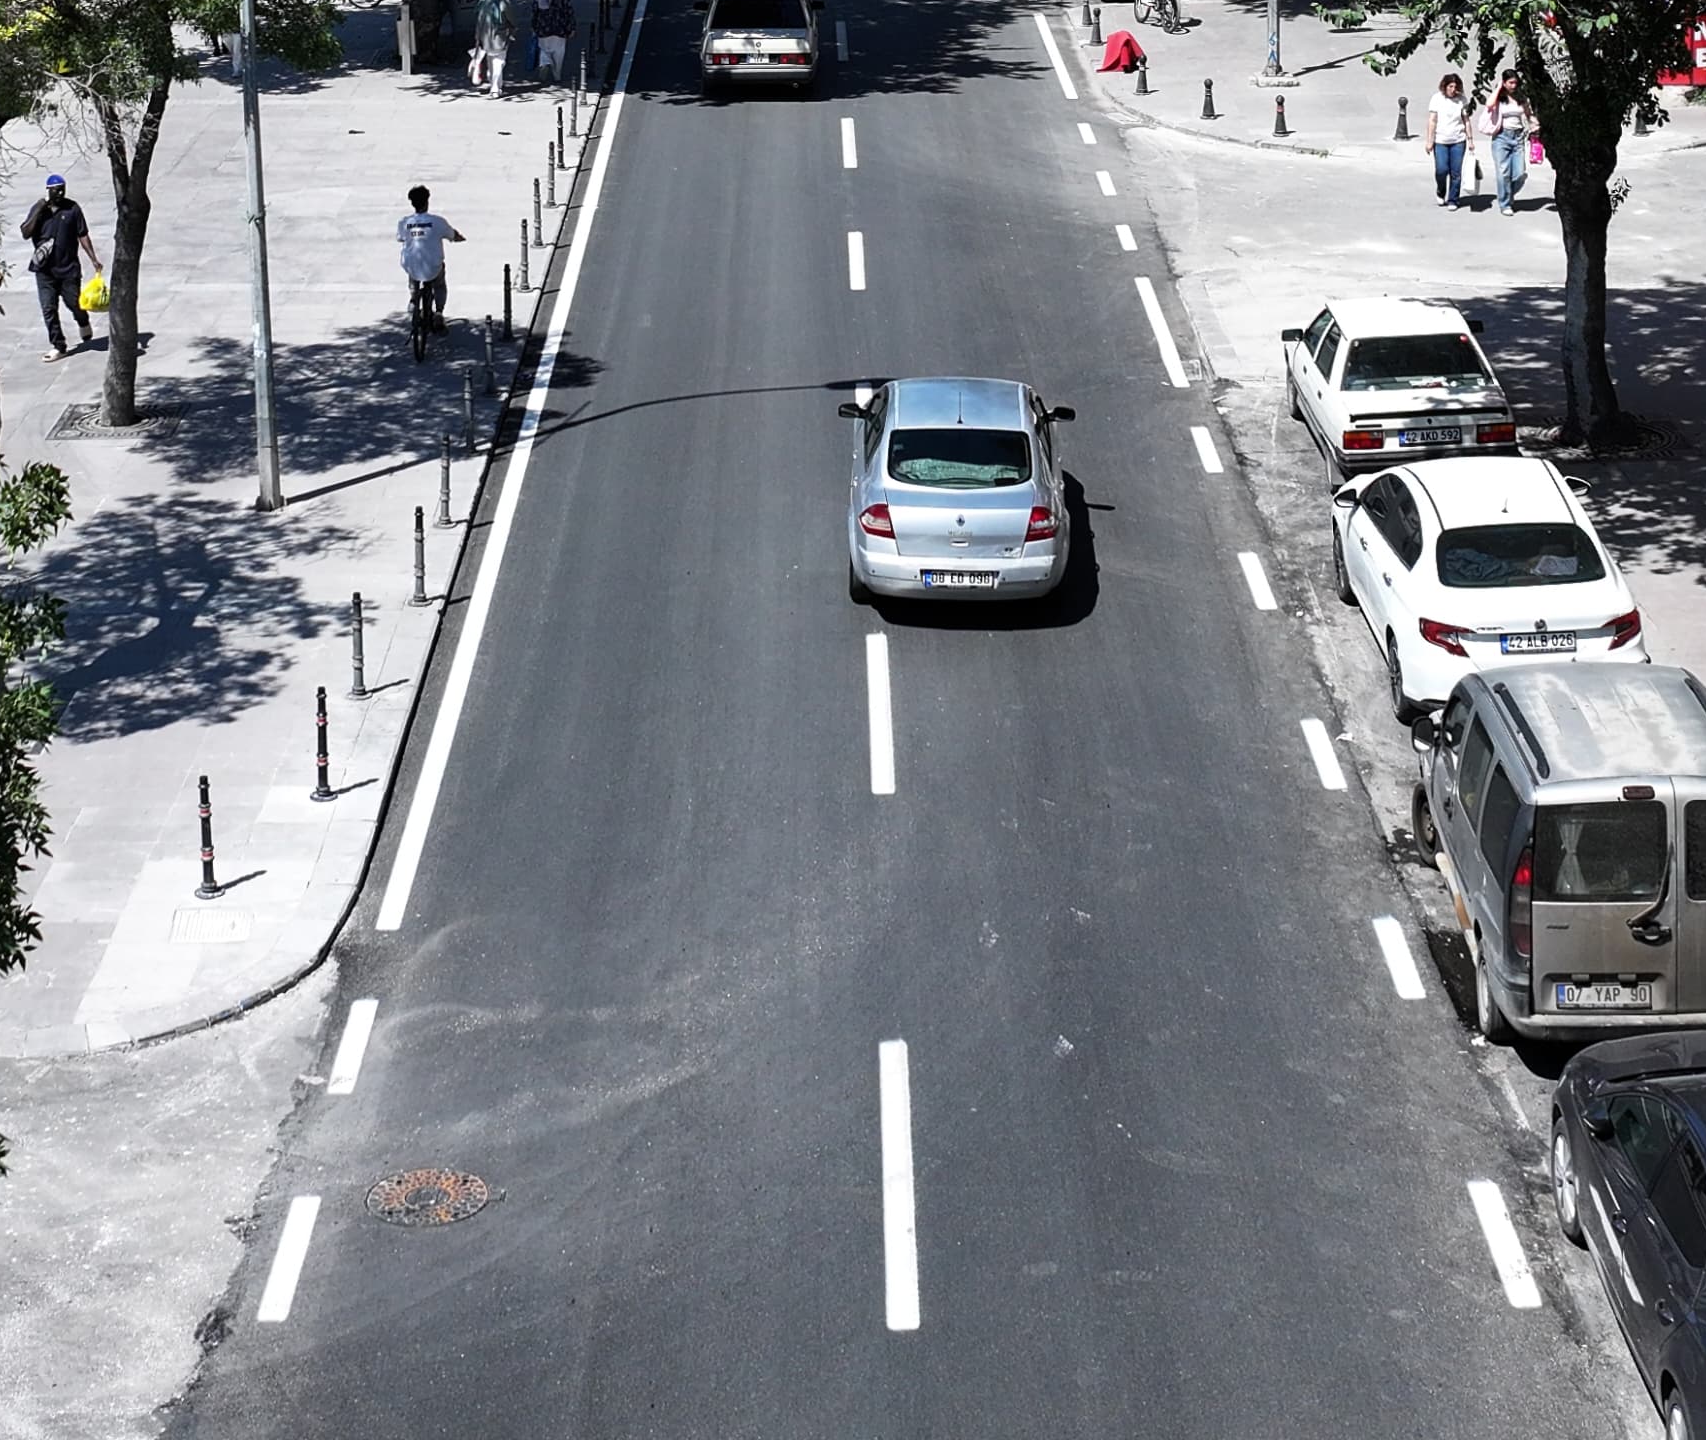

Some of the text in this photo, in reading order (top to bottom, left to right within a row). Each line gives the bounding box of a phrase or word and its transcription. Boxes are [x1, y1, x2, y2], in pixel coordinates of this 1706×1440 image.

[1405, 433, 1417, 442] 42
[1440, 430, 1459, 441] 592
[1508, 633, 1574, 649] 42 ALB 026
[1566, 987, 1647, 1002] 07 YAP 90
